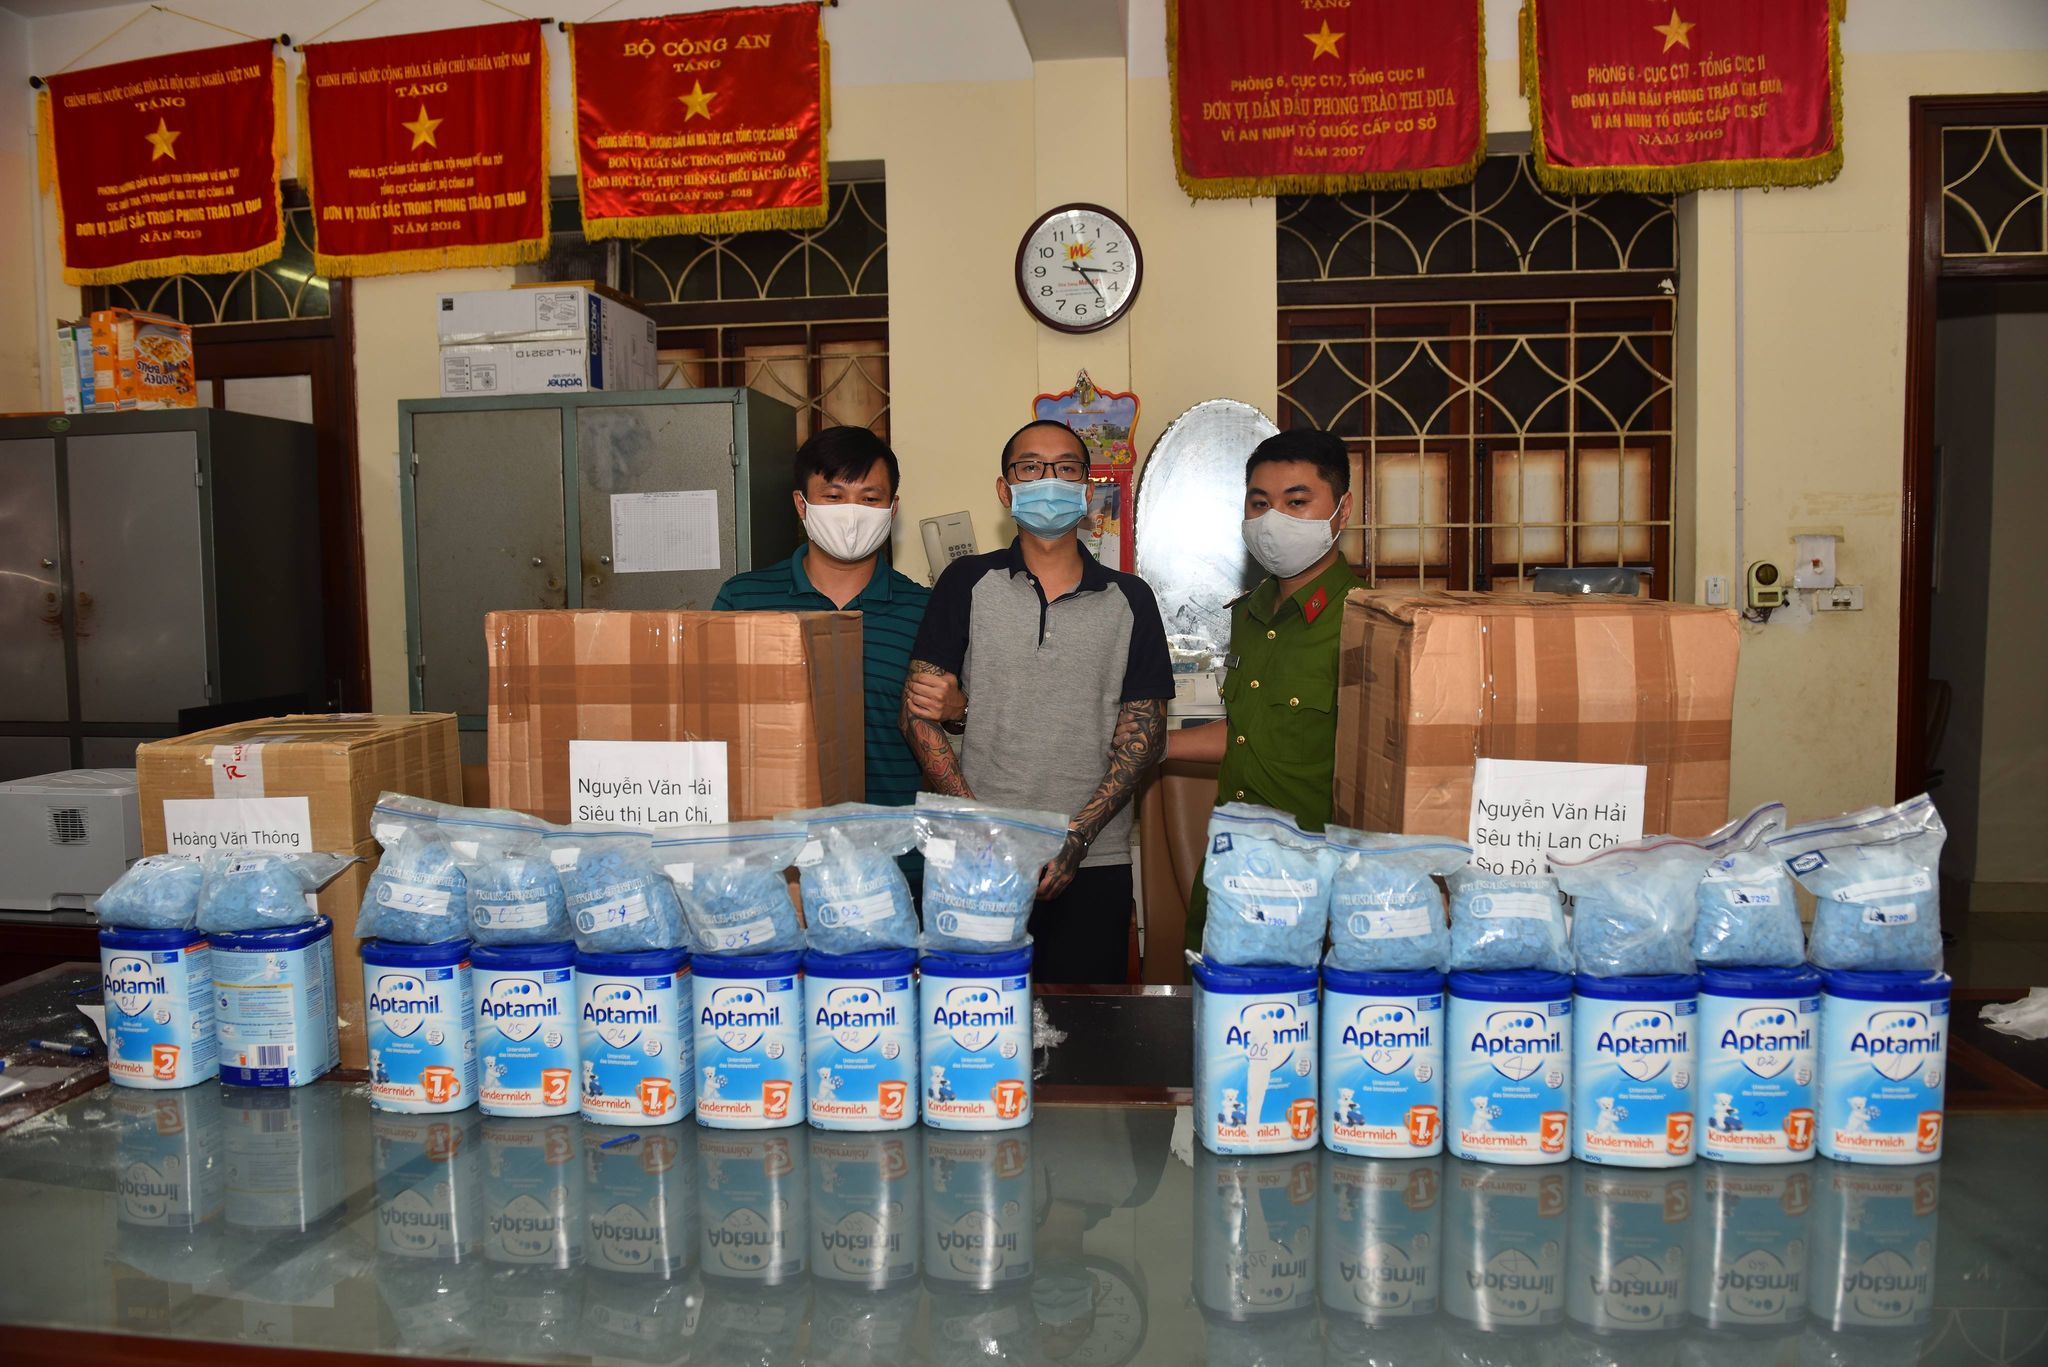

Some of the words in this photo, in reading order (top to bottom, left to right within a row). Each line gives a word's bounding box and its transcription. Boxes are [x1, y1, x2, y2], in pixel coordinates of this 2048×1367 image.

[624, 38, 656, 59] BỘ
[662, 38, 728, 57] CÔNG
[734, 34, 772, 49] AN
[1628, 65, 1635, 81] 6
[1644, 65, 1668, 88] CỤC
[1669, 62, 1689, 80] C17
[1699, 51, 1732, 77] TỔNG
[1231, 75, 1274, 91] PHÒNG
[1291, 74, 1317, 92] CỤC
[1319, 74, 1347, 89] C17,
[1349, 67, 1385, 86] TỔNG
[1387, 69, 1414, 85] CỤC
[1234, 101, 1249, 124] VỊ
[1313, 96, 1359, 116] PHONG
[1361, 88, 1398, 112] TRÀO
[1399, 90, 1424, 110] THI
[1426, 88, 1456, 107] ĐUA
[1239, 129, 1259, 141] AN
[1262, 124, 1296, 140] NINH
[1299, 118, 1317, 139] TỔ
[1320, 119, 1360, 138] QUỐC
[1417, 112, 1438, 131] SỞ
[1685, 128, 1724, 144] 2009
[1331, 145, 1367, 157] 2007
[1053, 231, 1064, 242] 11
[1070, 223, 1086, 234] 12
[1095, 227, 1101, 238] 1
[1039, 247, 1055, 258] 10
[1105, 242, 1119, 254] 2
[1034, 266, 1047, 278] 9
[1111, 261, 1125, 273] 3
[1041, 285, 1054, 297] 8
[1107, 281, 1120, 292] 4
[1056, 299, 1067, 311] 7
[1074, 304, 1087, 315] 6
[1094, 297, 1105, 309] 5
[547, 377, 582, 388] brother
[578, 776, 642, 798] Nguyễn
[648, 779, 681, 796] Văn
[688, 777, 712, 795] Hải
[579, 804, 614, 821] Siêu
[620, 806, 642, 825] thị
[647, 807, 679, 823] Lan
[685, 806, 713, 825] Chi,
[1477, 799, 1545, 821] Nguyễn
[1551, 802, 1588, 821] Văn
[1594, 802, 1627, 822] Hải
[172, 831, 217, 848] Hoàng
[220, 831, 248, 846] Văn
[252, 830, 300, 847] Thông
[1517, 830, 1541, 851] thị
[1548, 832, 1582, 850] Lan
[1511, 858, 1537, 875] Đỏ
[104, 975, 166, 997] Aptamil
[369, 992, 439, 1015] Aptamil
[480, 997, 558, 1020] Aptamil
[583, 1002, 659, 1026] Aptamil
[701, 1006, 780, 1030] Aptamil
[815, 1006, 896, 1030] Aptamil
[933, 1005, 1014, 1029] Aptamil
[1226, 1021, 1309, 1050] Apmil
[1342, 1025, 1430, 1051] Aptamil
[1470, 1031, 1561, 1057] Aptamil
[1596, 1031, 1688, 1057] Aptamil
[1721, 1029, 1811, 1055] Aptamil
[1250, 1042, 1269, 1058] 06
[1850, 1031, 1941, 1058] Aptamil
[479, 1087, 532, 1101] Kindermilch
[581, 1094, 631, 1110] Kindermilch
[698, 1100, 752, 1114] Kindermilch
[811, 1100, 868, 1115] Kindermilch
[927, 1099, 985, 1114] Kindermilch
[1217, 1124, 1280, 1138] Kindemilch
[1333, 1124, 1397, 1140] Kindermilch
[1461, 1130, 1528, 1146] Kindermilch
[1707, 1129, 1776, 1145] Kindermilch
[1835, 1131, 1905, 1148] Kindermilch
[1586, 1132, 1655, 1149] Kindermilch
